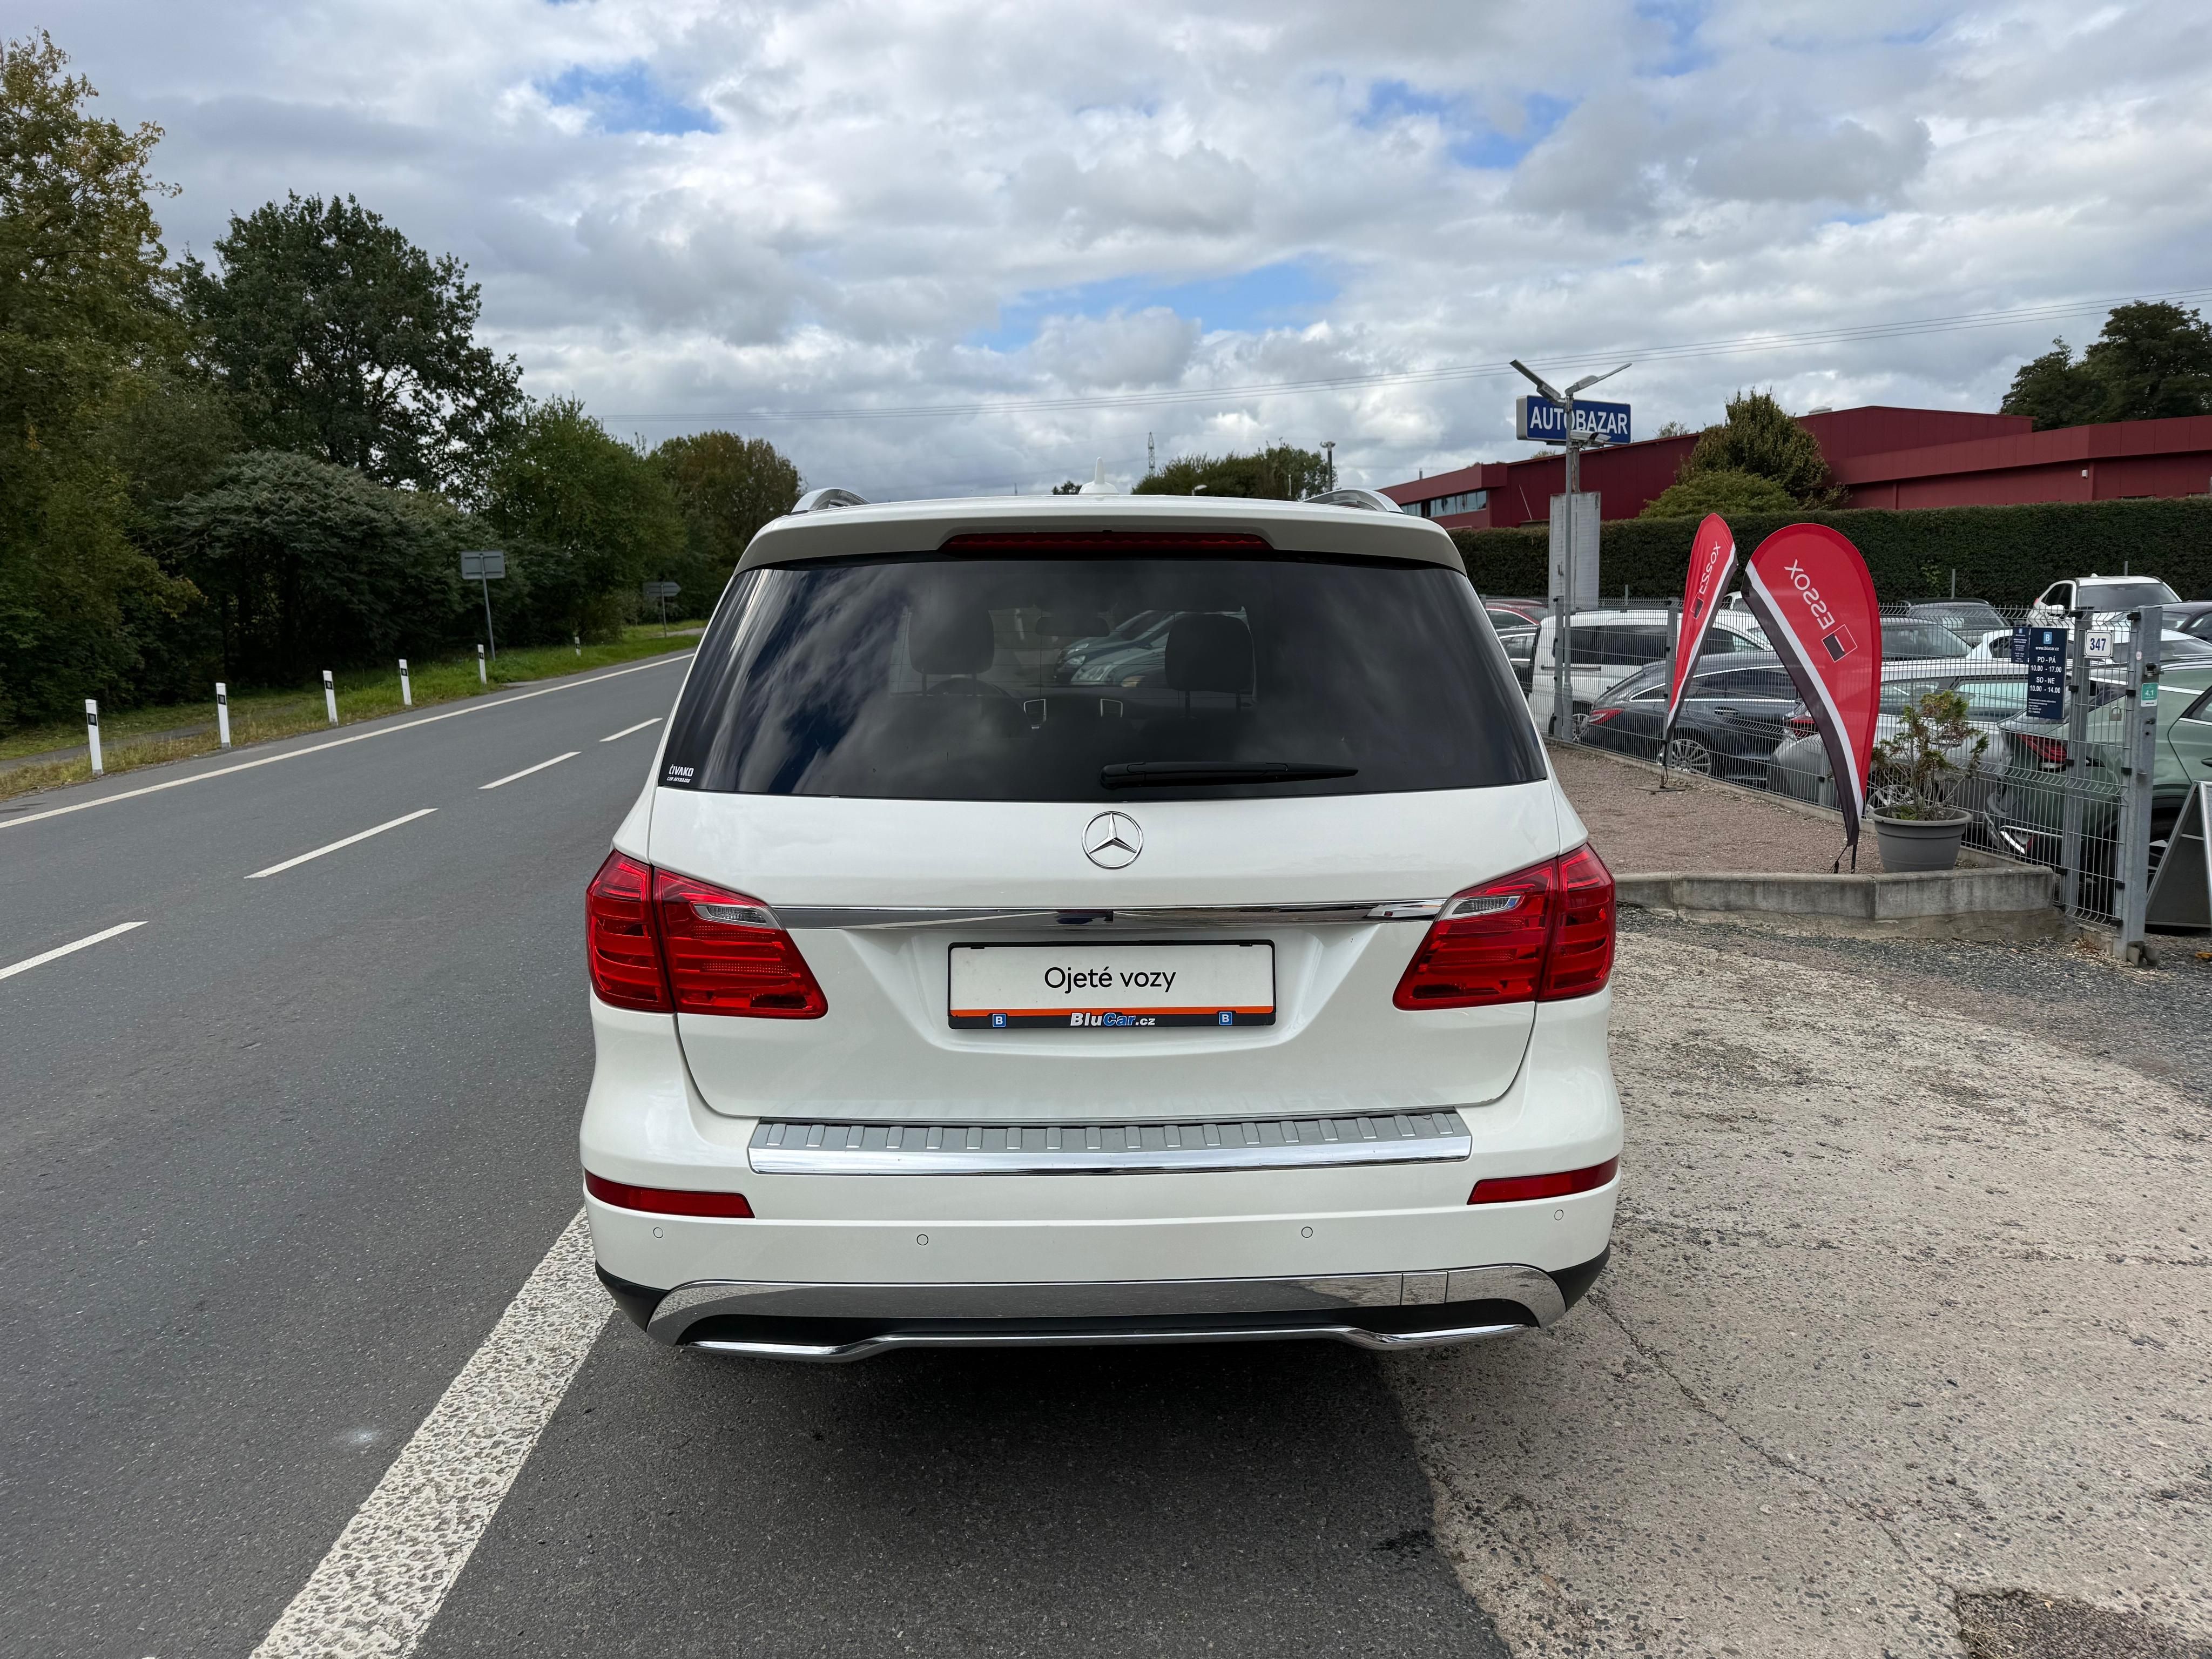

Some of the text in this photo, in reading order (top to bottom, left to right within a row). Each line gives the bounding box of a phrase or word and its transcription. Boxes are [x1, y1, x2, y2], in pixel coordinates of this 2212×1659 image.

[1698, 541, 1721, 595] ESSOX
[2090, 638, 2106, 651] 347
[1044, 966, 1176, 994] Ojeté vozy
[1070, 1013, 1156, 1026] BluCar.cz
